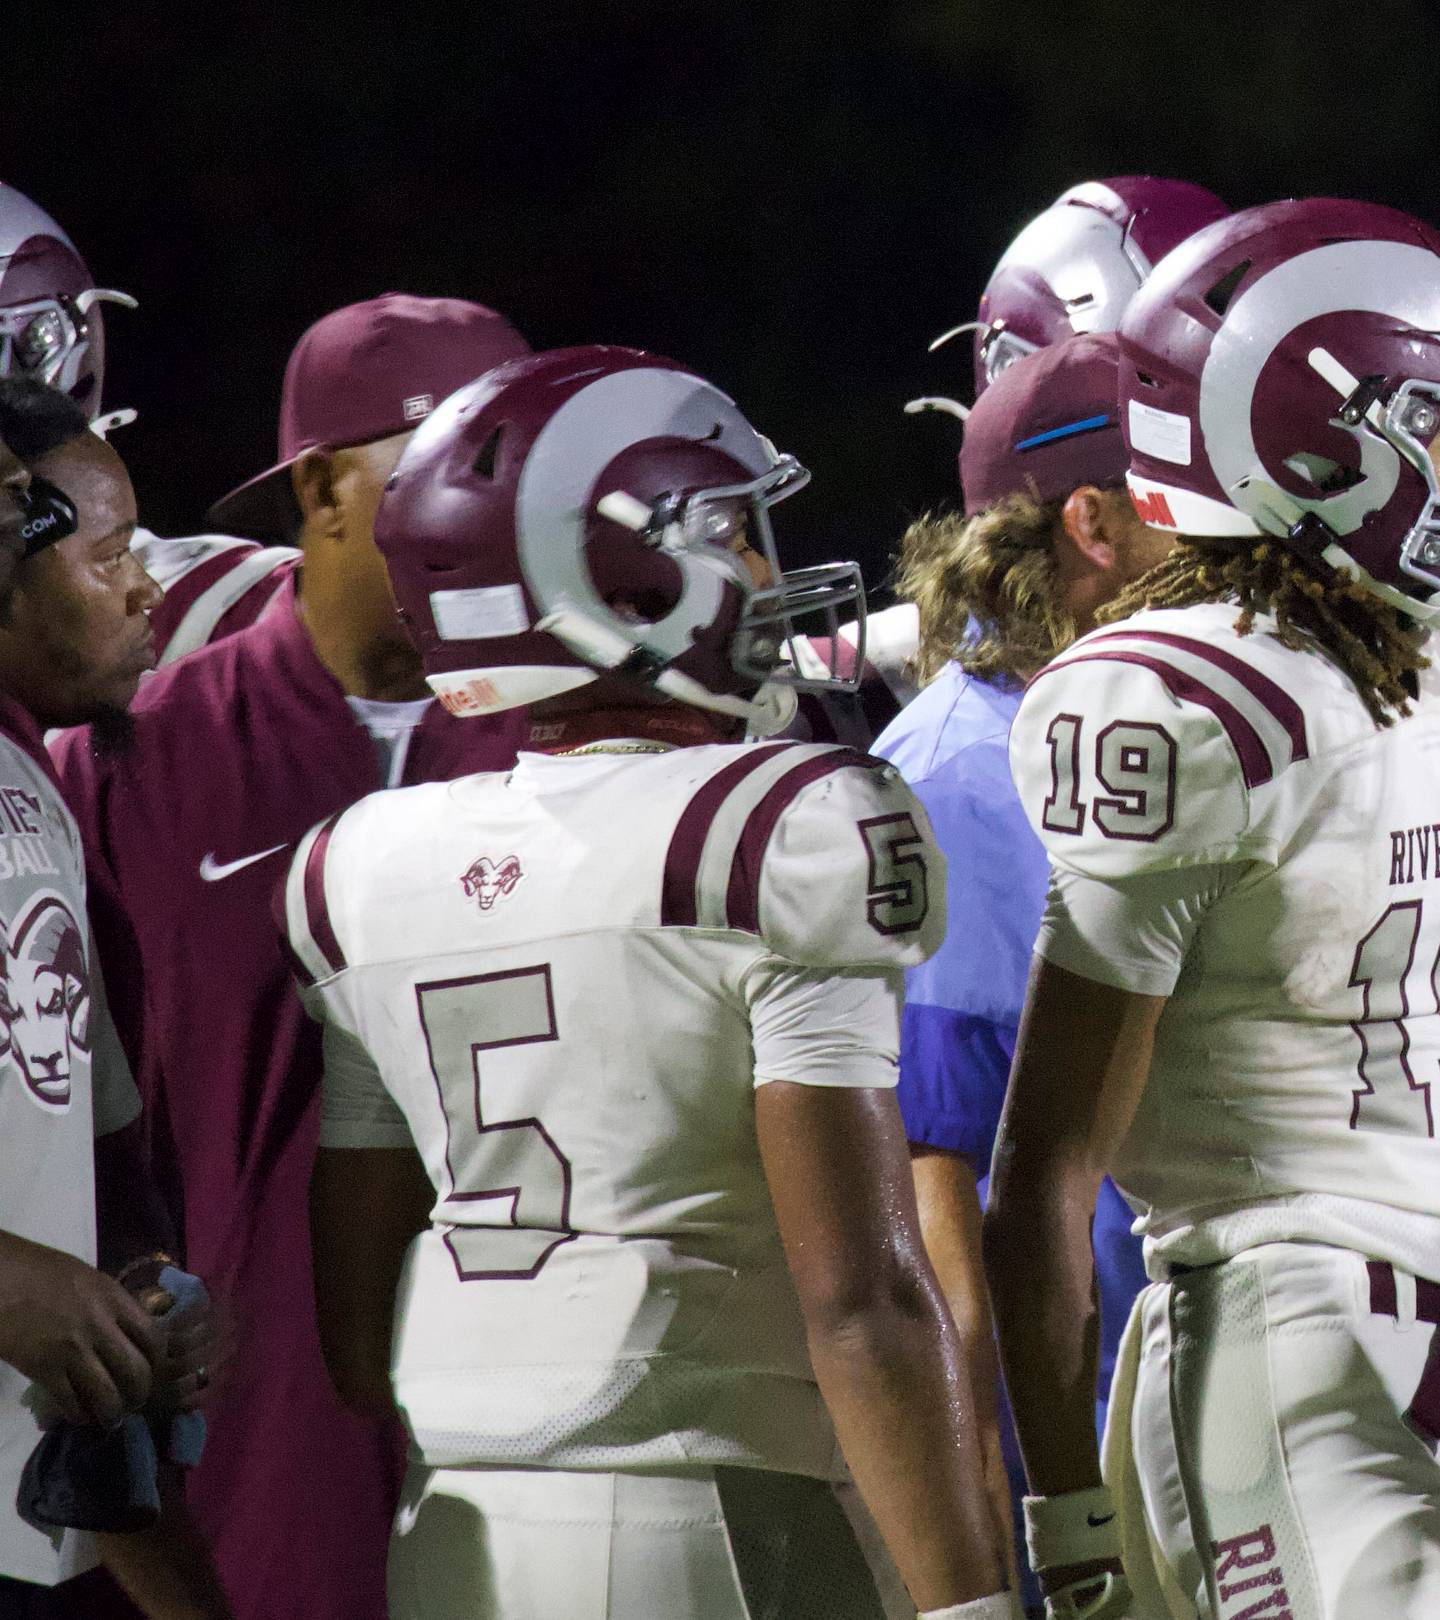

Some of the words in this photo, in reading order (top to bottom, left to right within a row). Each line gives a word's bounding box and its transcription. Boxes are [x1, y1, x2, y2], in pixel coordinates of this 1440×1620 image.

[1042, 712, 1177, 842] 19
[858, 811, 931, 937] 5
[415, 962, 580, 1283] 5
